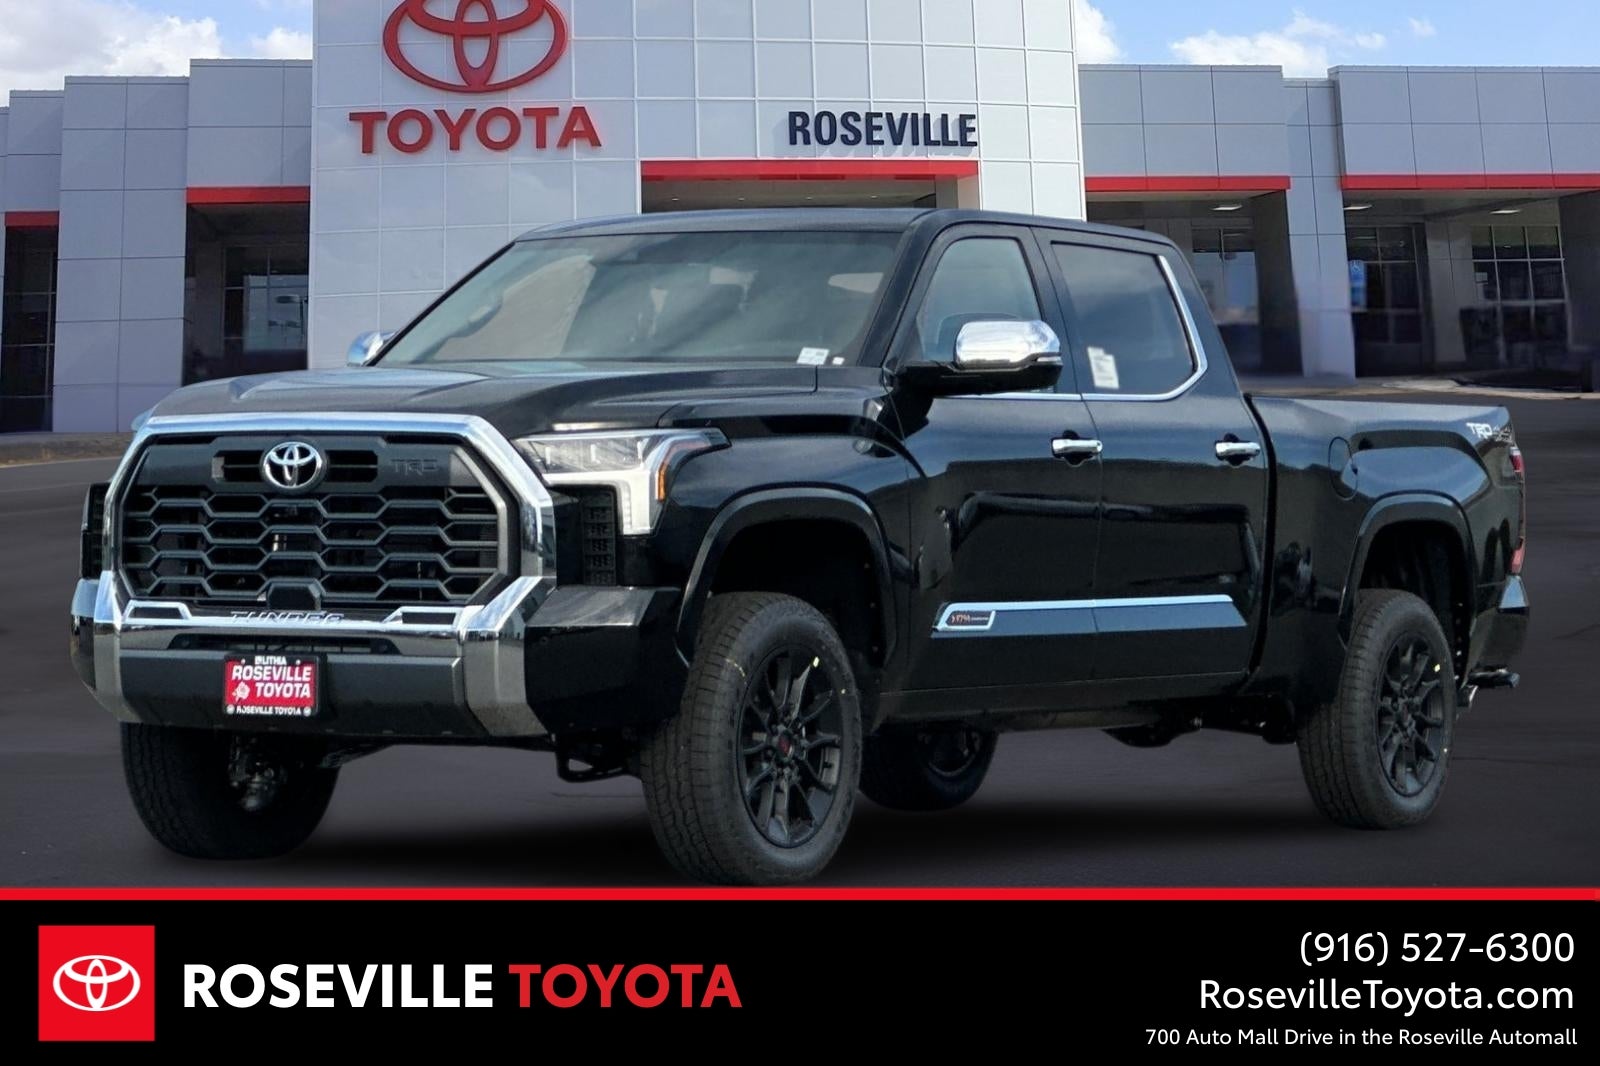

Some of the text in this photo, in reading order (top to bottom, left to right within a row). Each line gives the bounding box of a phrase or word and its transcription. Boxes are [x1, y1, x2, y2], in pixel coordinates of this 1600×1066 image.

[349, 106, 602, 154] TOYOTA
[788, 110, 978, 147] ROSEVILLE
[1466, 422, 1493, 440] TRD
[391, 459, 440, 476] TRD
[232, 665, 312, 682] ROSEVILLE
[255, 682, 311, 698] TOYOTA
[236, 705, 302, 715] ROSEVILLE TOYOTA
